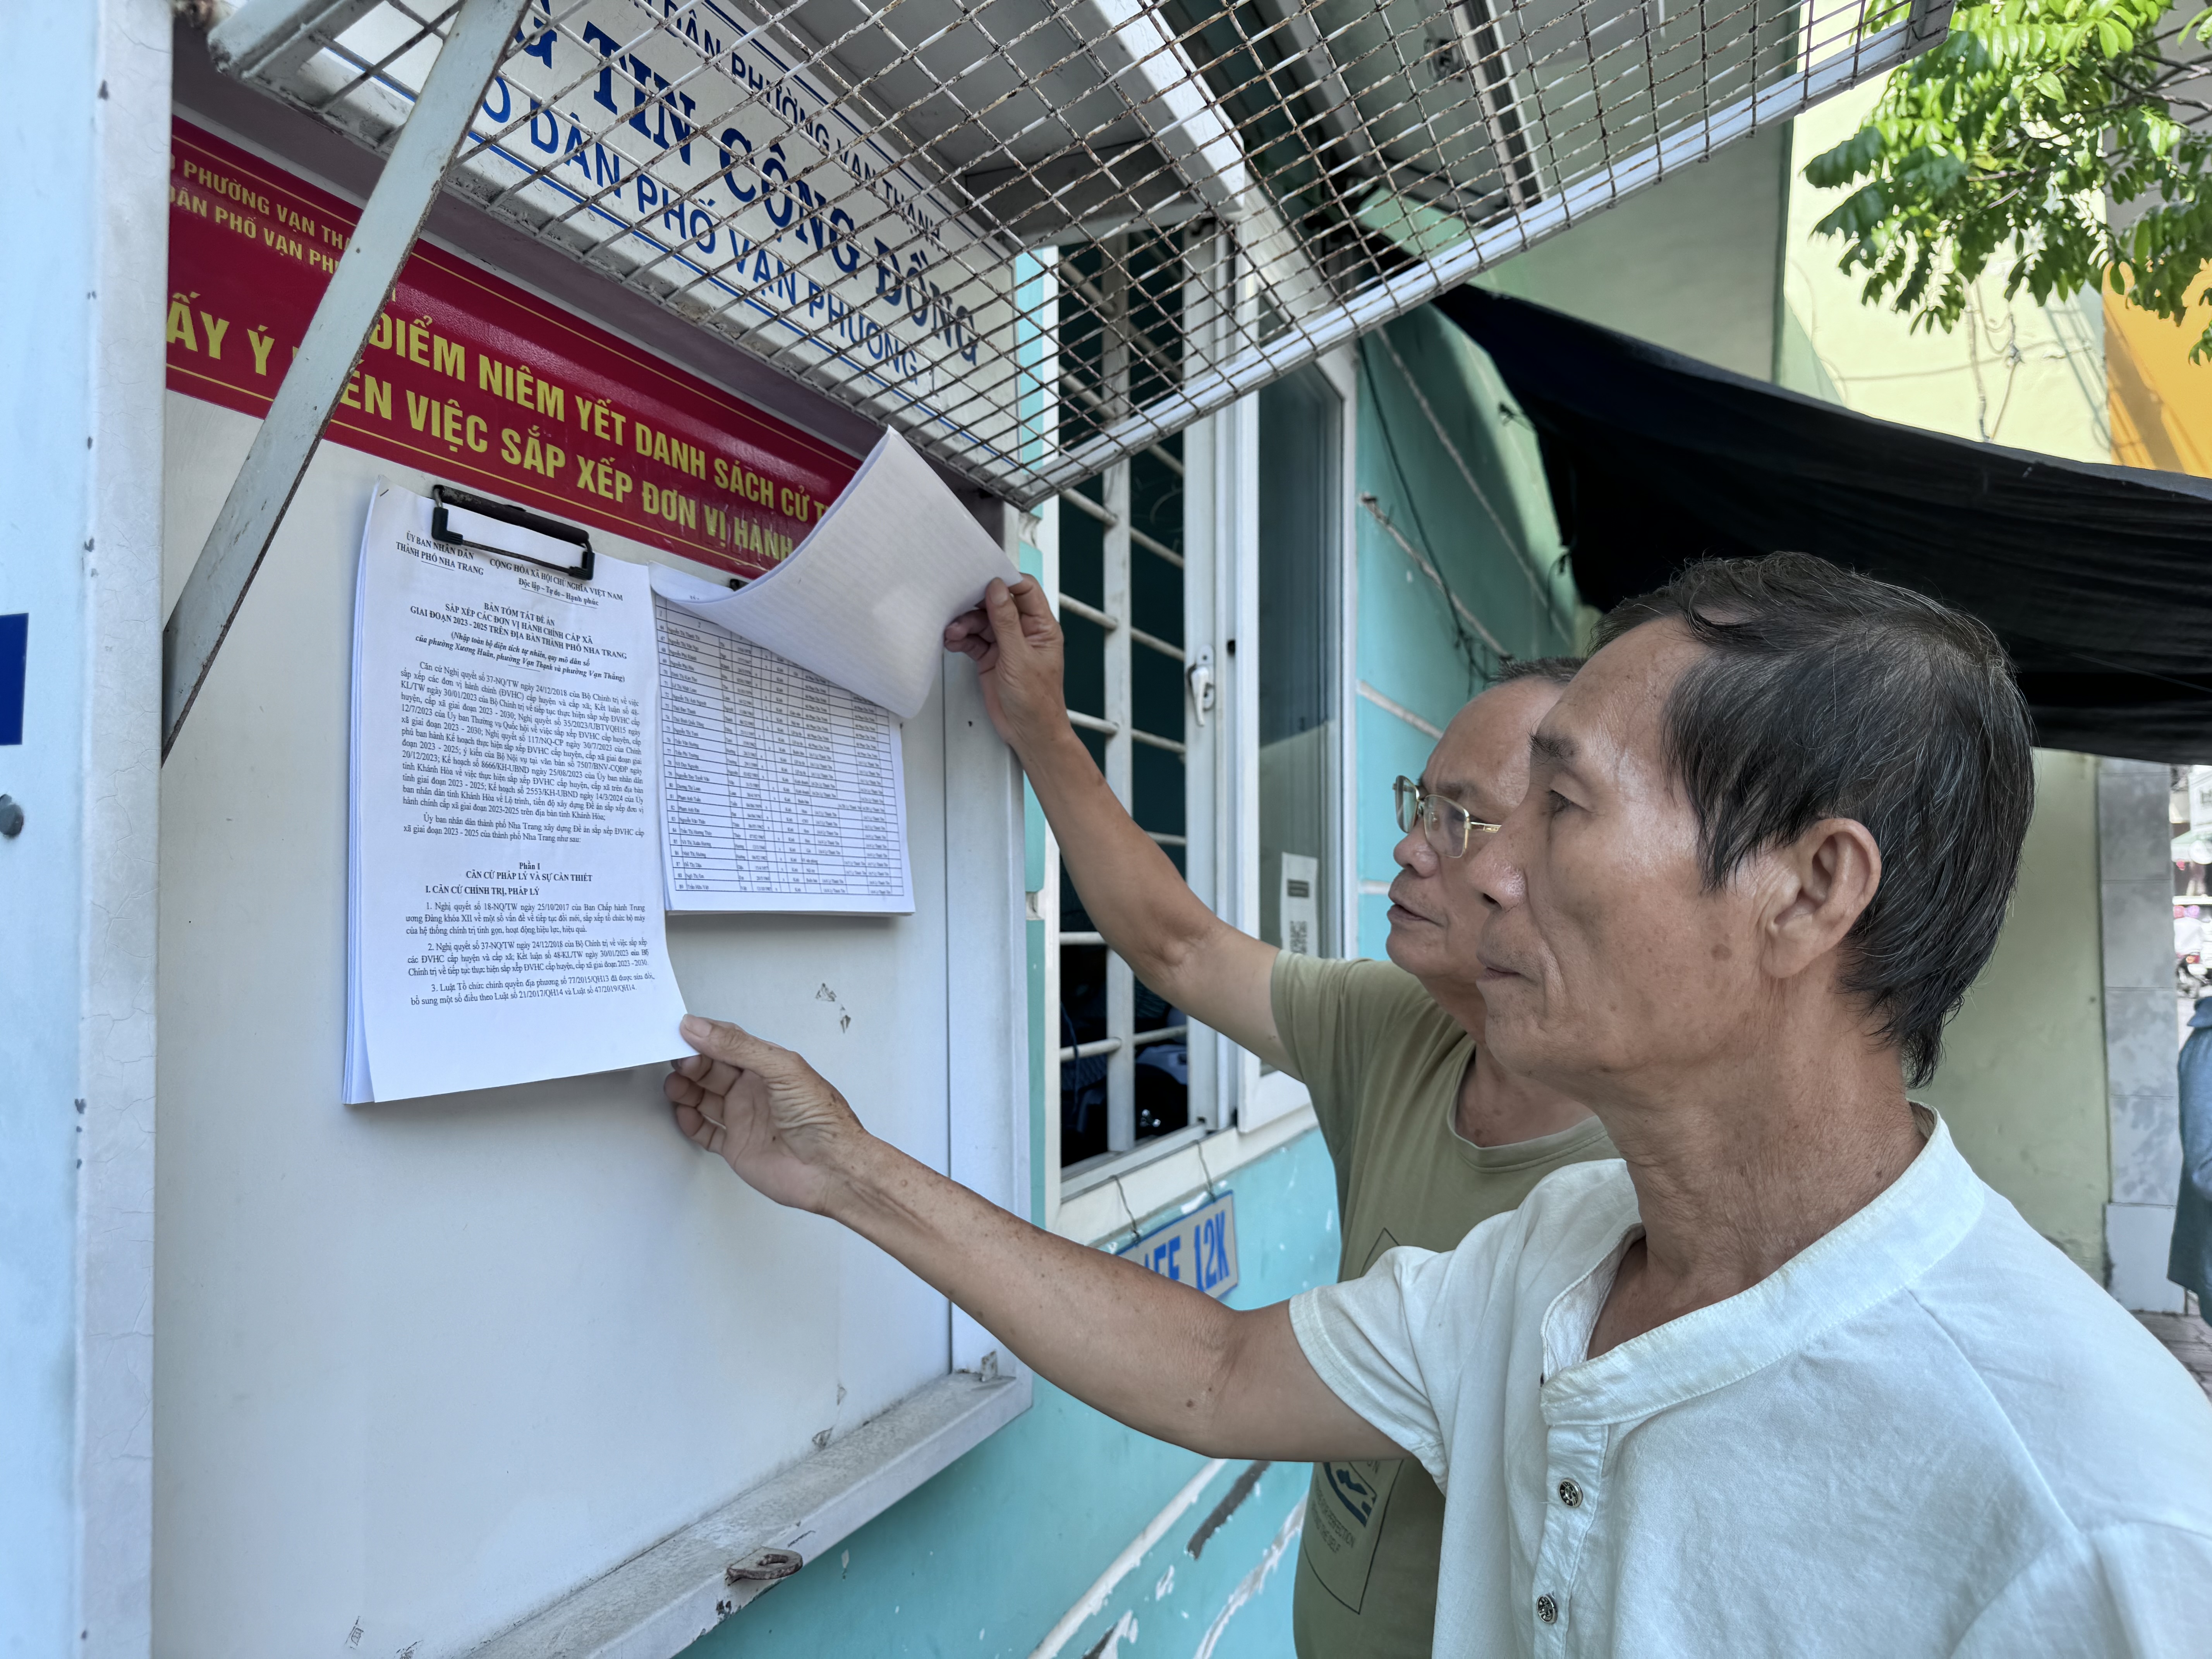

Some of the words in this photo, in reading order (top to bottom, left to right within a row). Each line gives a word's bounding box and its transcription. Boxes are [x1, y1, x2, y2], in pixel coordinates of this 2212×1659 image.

[583, 21, 696, 166] TIN
[184, 159, 270, 216] PHƯỜNG
[276, 203, 315, 237] VẠN
[637, 173, 716, 254] PHỐ
[215, 205, 257, 239] PHỐ
[264, 228, 302, 260] VẠN
[310, 248, 339, 274] PH
[167, 291, 230, 360] ẤY
[246, 325, 275, 376] Ý
[406, 390, 488, 452] VIỆC
[500, 424, 566, 479] SẮP
[576, 454, 633, 503] XẾP
[642, 480, 697, 531] ĐƠN
[704, 504, 726, 547] VỊ
[479, 354, 565, 422] NIÊM
[574, 394, 627, 447] YẾT
[635, 422, 706, 481] DANH
[713, 458, 774, 509] SÁCH
[781, 485, 810, 523] CỬ
[417, 537, 431, 548] BAN
[439, 556, 455, 568] NHA
[457, 562, 483, 575] TRANG
[410, 606, 428, 617] GIAI
[429, 610, 452, 623] ĐOẠN
[453, 617, 468, 626] 2023
[473, 622, 487, 631] 2025
[489, 625, 508, 636] TRÊN
[510, 630, 524, 640] ĐỊA
[526, 632, 540, 642] BÀN
[542, 637, 563, 649] THÀNH
[583, 646, 600, 654] NHA
[601, 649, 627, 659] TRANG
[477, 611, 492, 622] CÁC
[512, 620, 519, 630] VỊ
[522, 622, 542, 633] HÀNH
[607, 592, 623, 601] NAM
[1194, 1211, 1230, 1292] 12K
